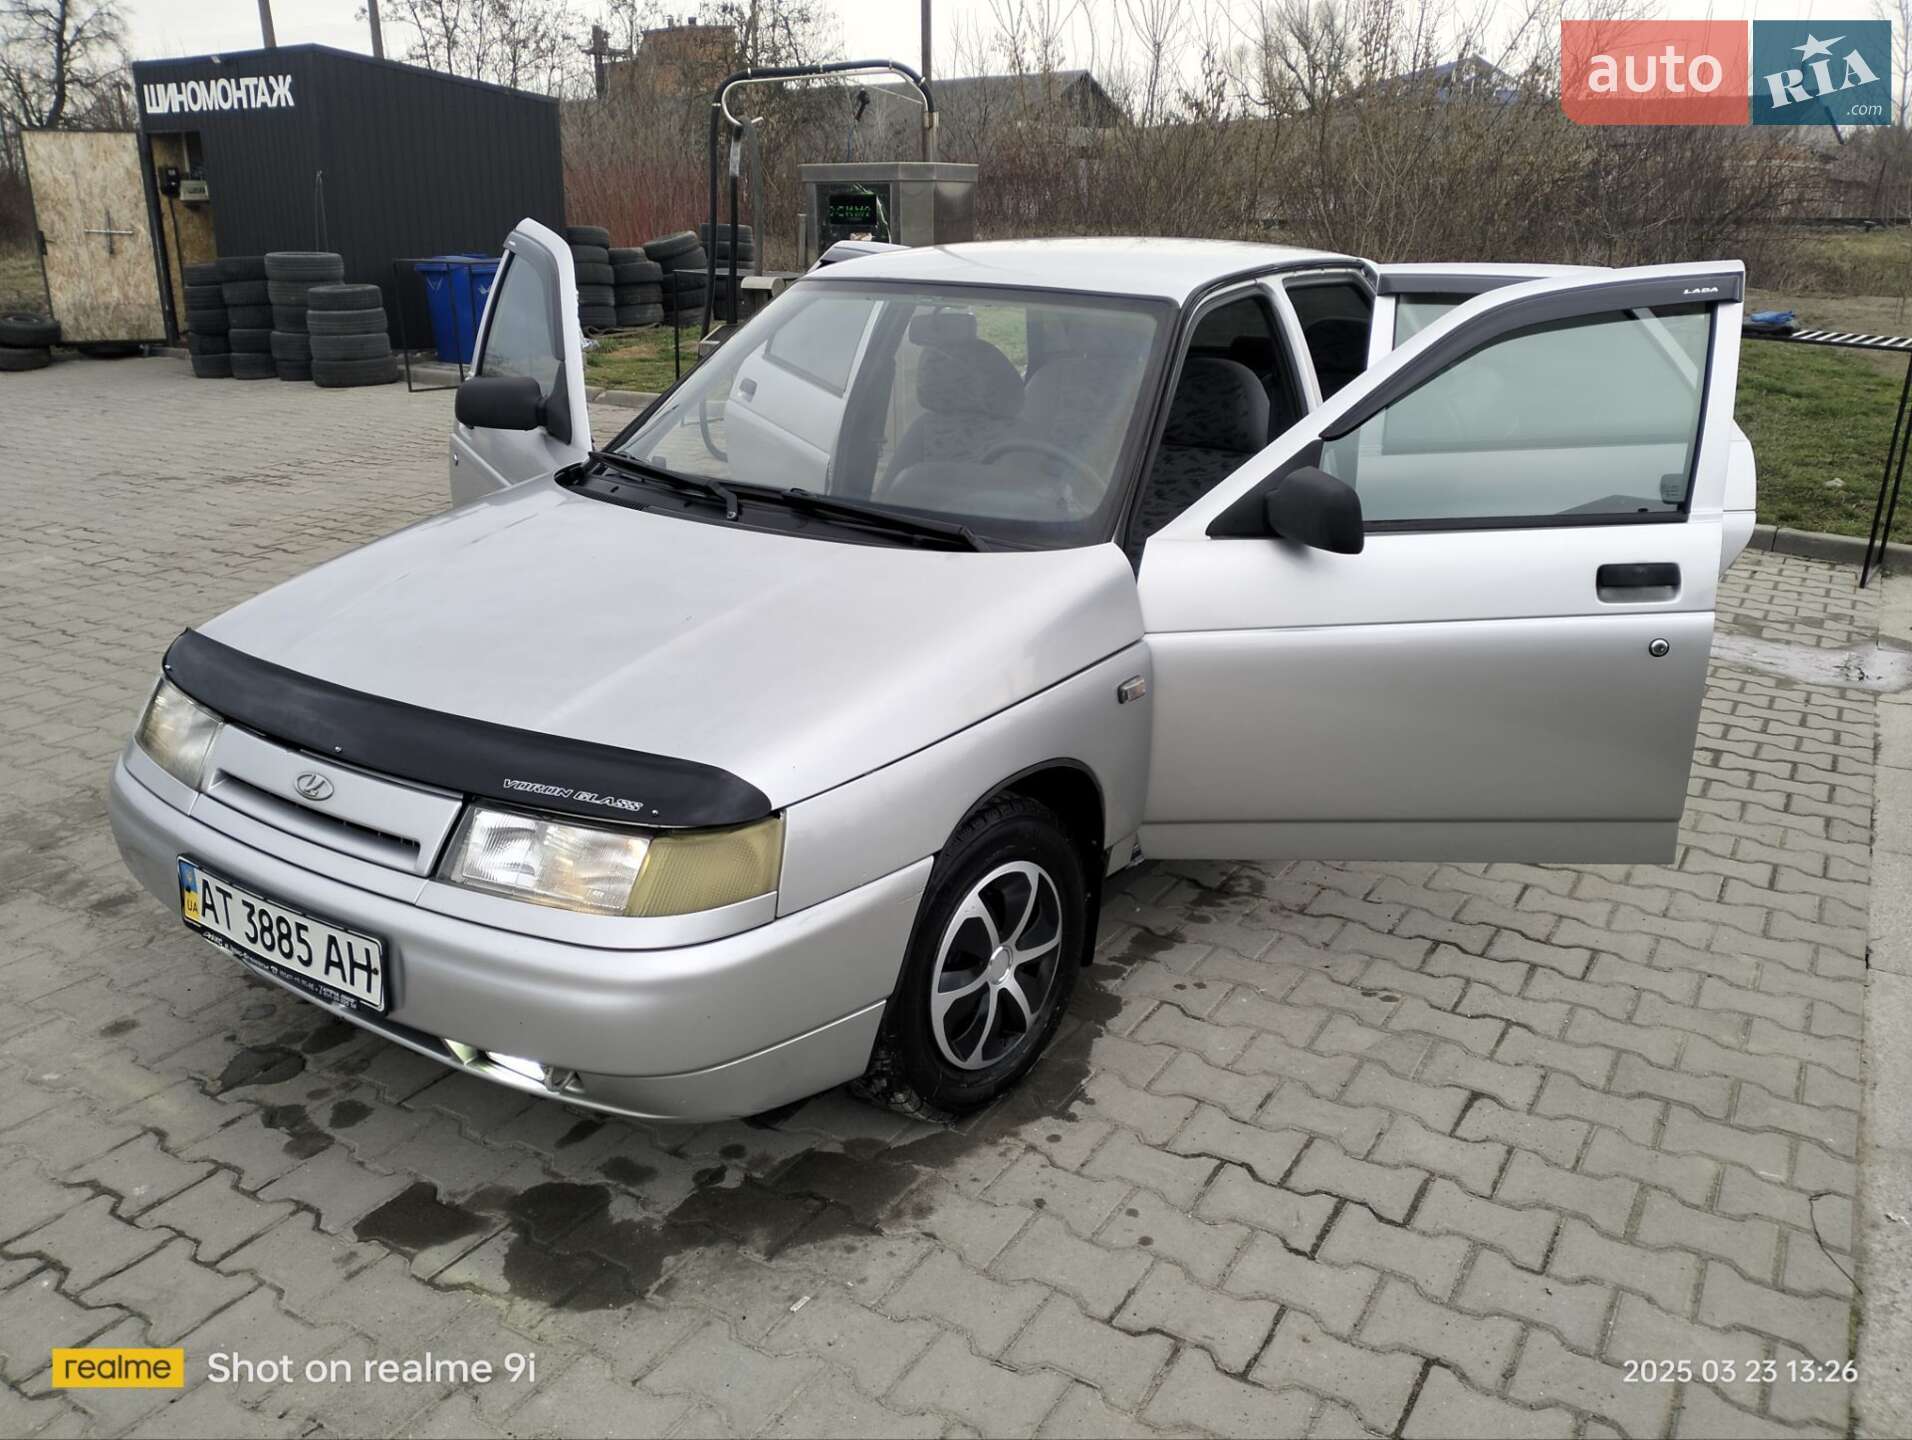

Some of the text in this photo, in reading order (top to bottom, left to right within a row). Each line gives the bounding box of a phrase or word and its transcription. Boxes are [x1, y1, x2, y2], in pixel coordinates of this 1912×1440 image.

[143, 74, 295, 114] ШИНОМОНТАЖ
[1683, 286, 1719, 295] LADA
[503, 778, 643, 812] VORON GLASS
[186, 900, 198, 913] UA
[201, 878, 233, 932] AT
[242, 899, 313, 968] 3885
[324, 933, 372, 994] AH
